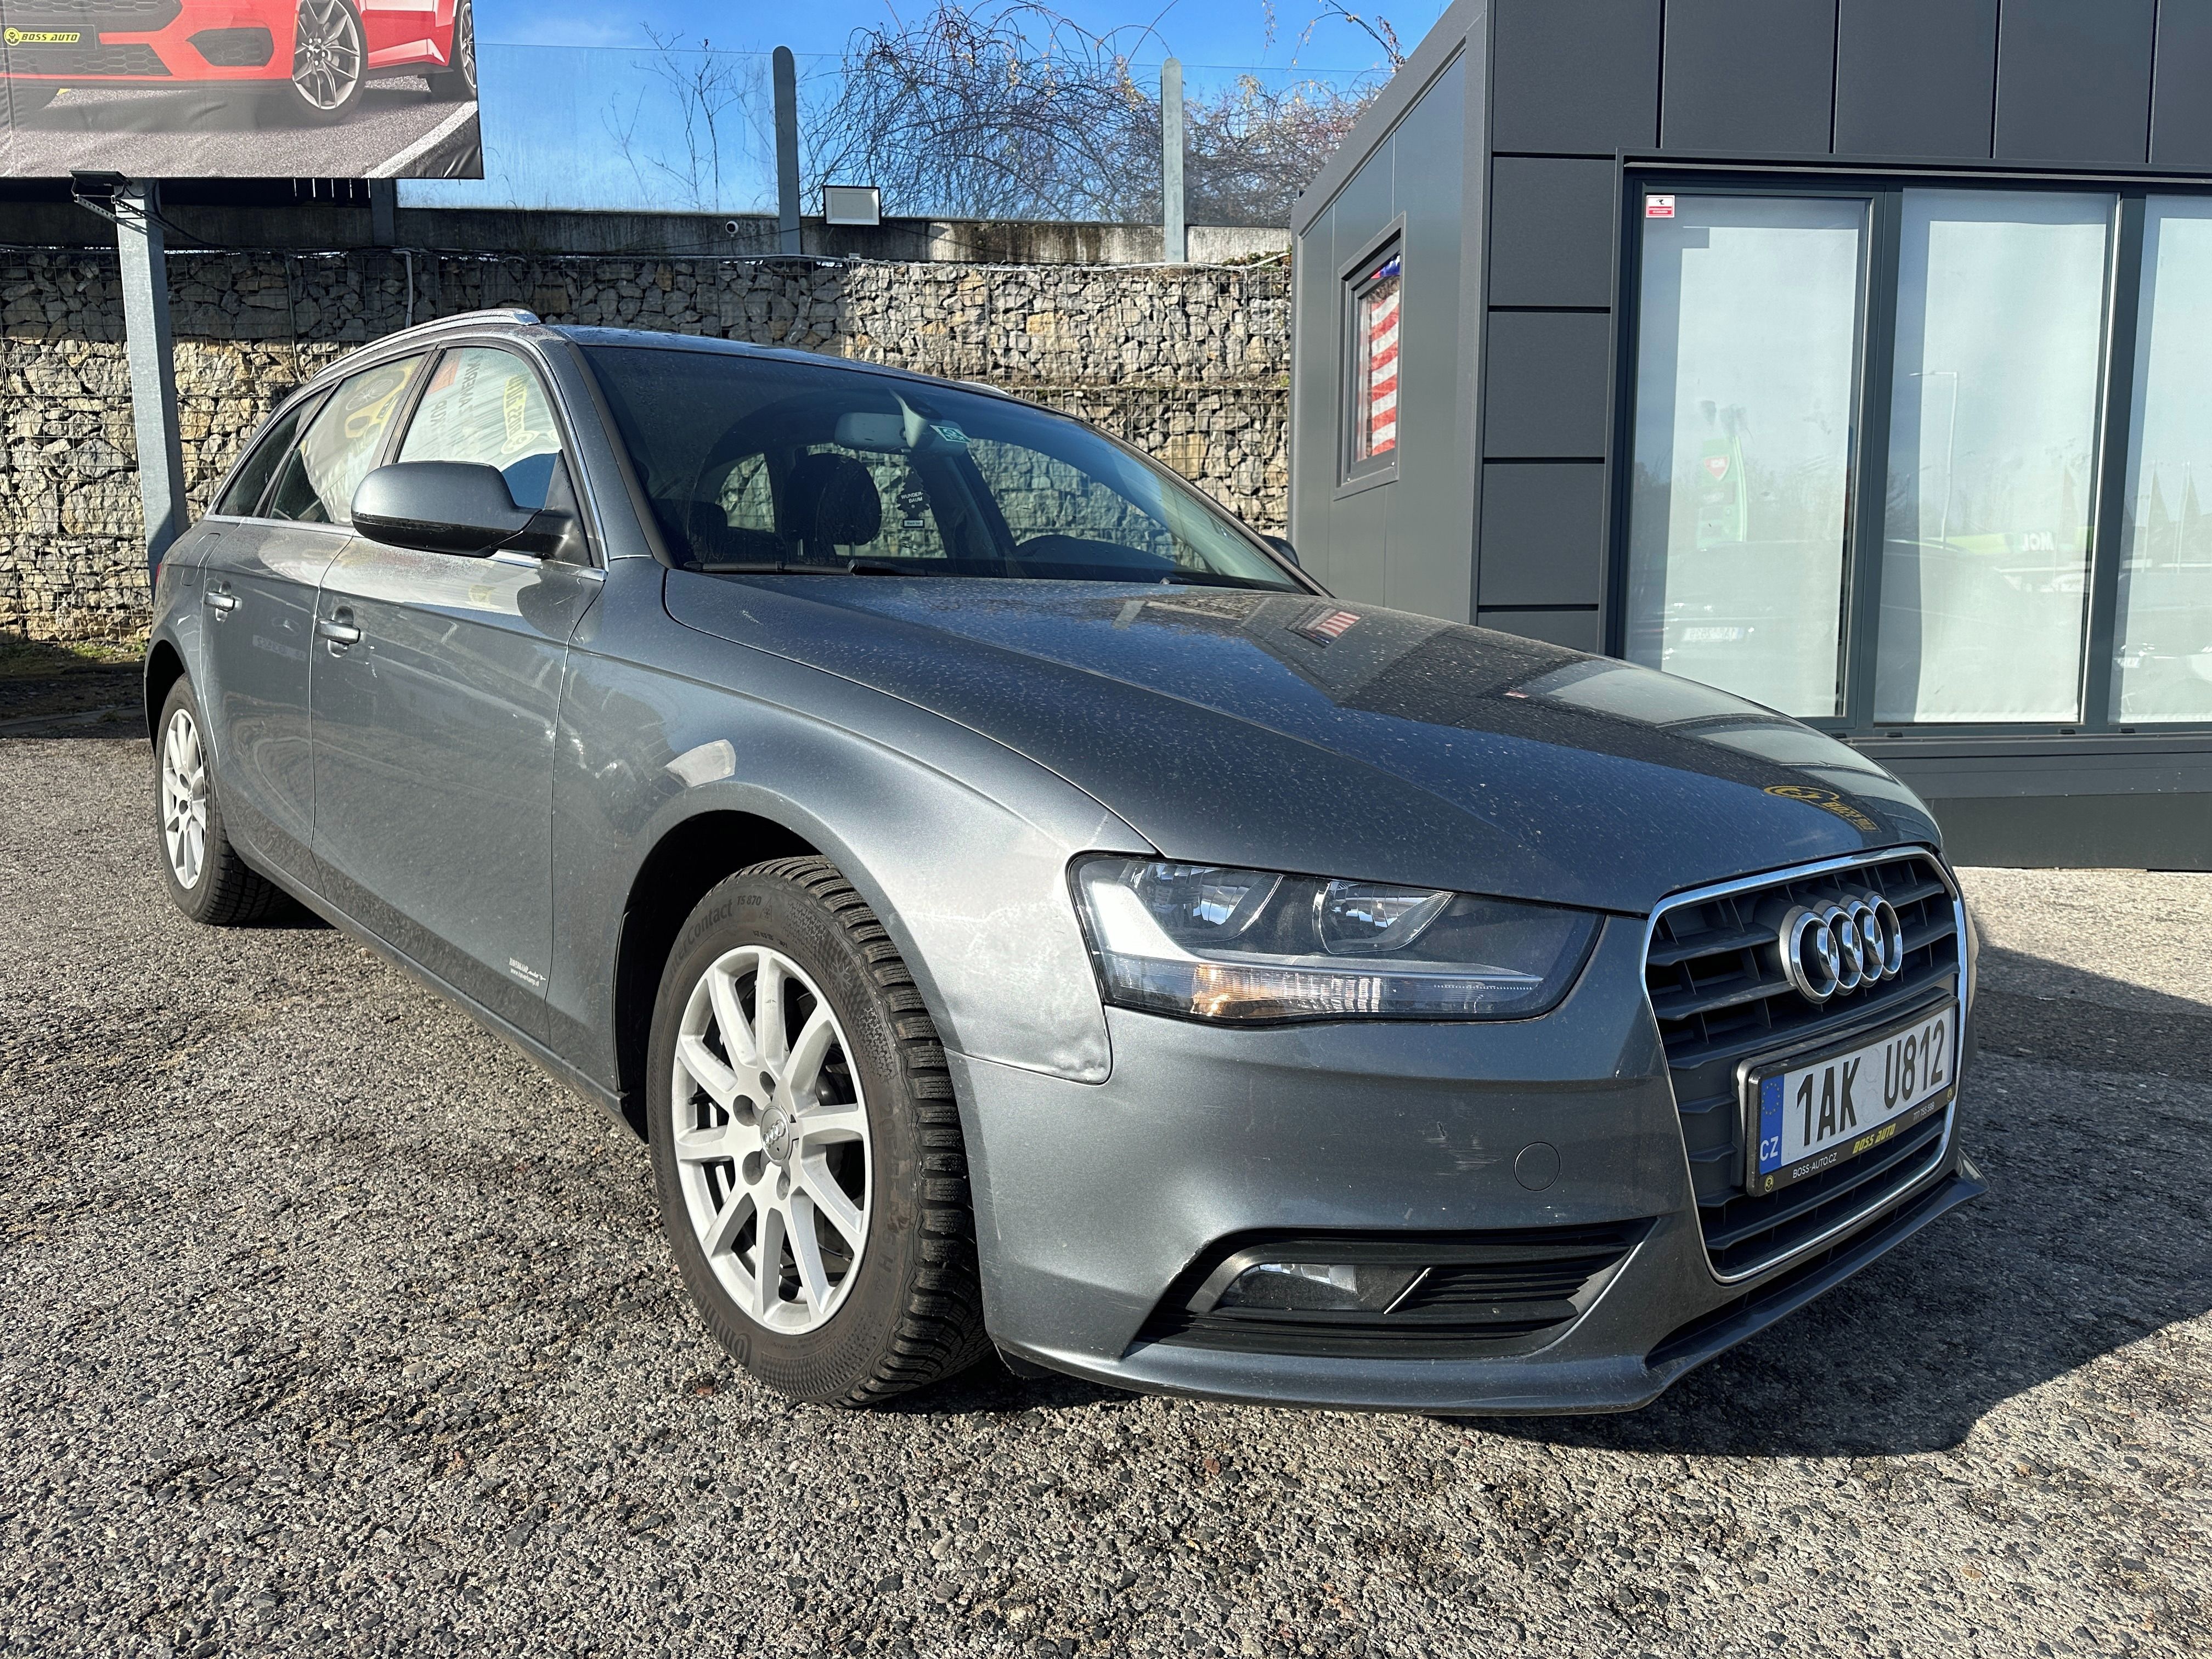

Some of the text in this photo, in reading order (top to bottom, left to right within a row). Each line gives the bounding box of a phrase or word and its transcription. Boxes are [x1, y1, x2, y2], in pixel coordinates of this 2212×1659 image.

[736, 896, 744, 905] TS
[746, 895, 761, 906] 870
[1797, 1018, 1945, 1147] 1AK U812
[1760, 1136, 1779, 1161] CZ
[1793, 1152, 1837, 1178] BOSS-AUTO.CZ
[1853, 1133, 1875, 1154] BOSS
[1875, 1123, 1896, 1143] AUTO
